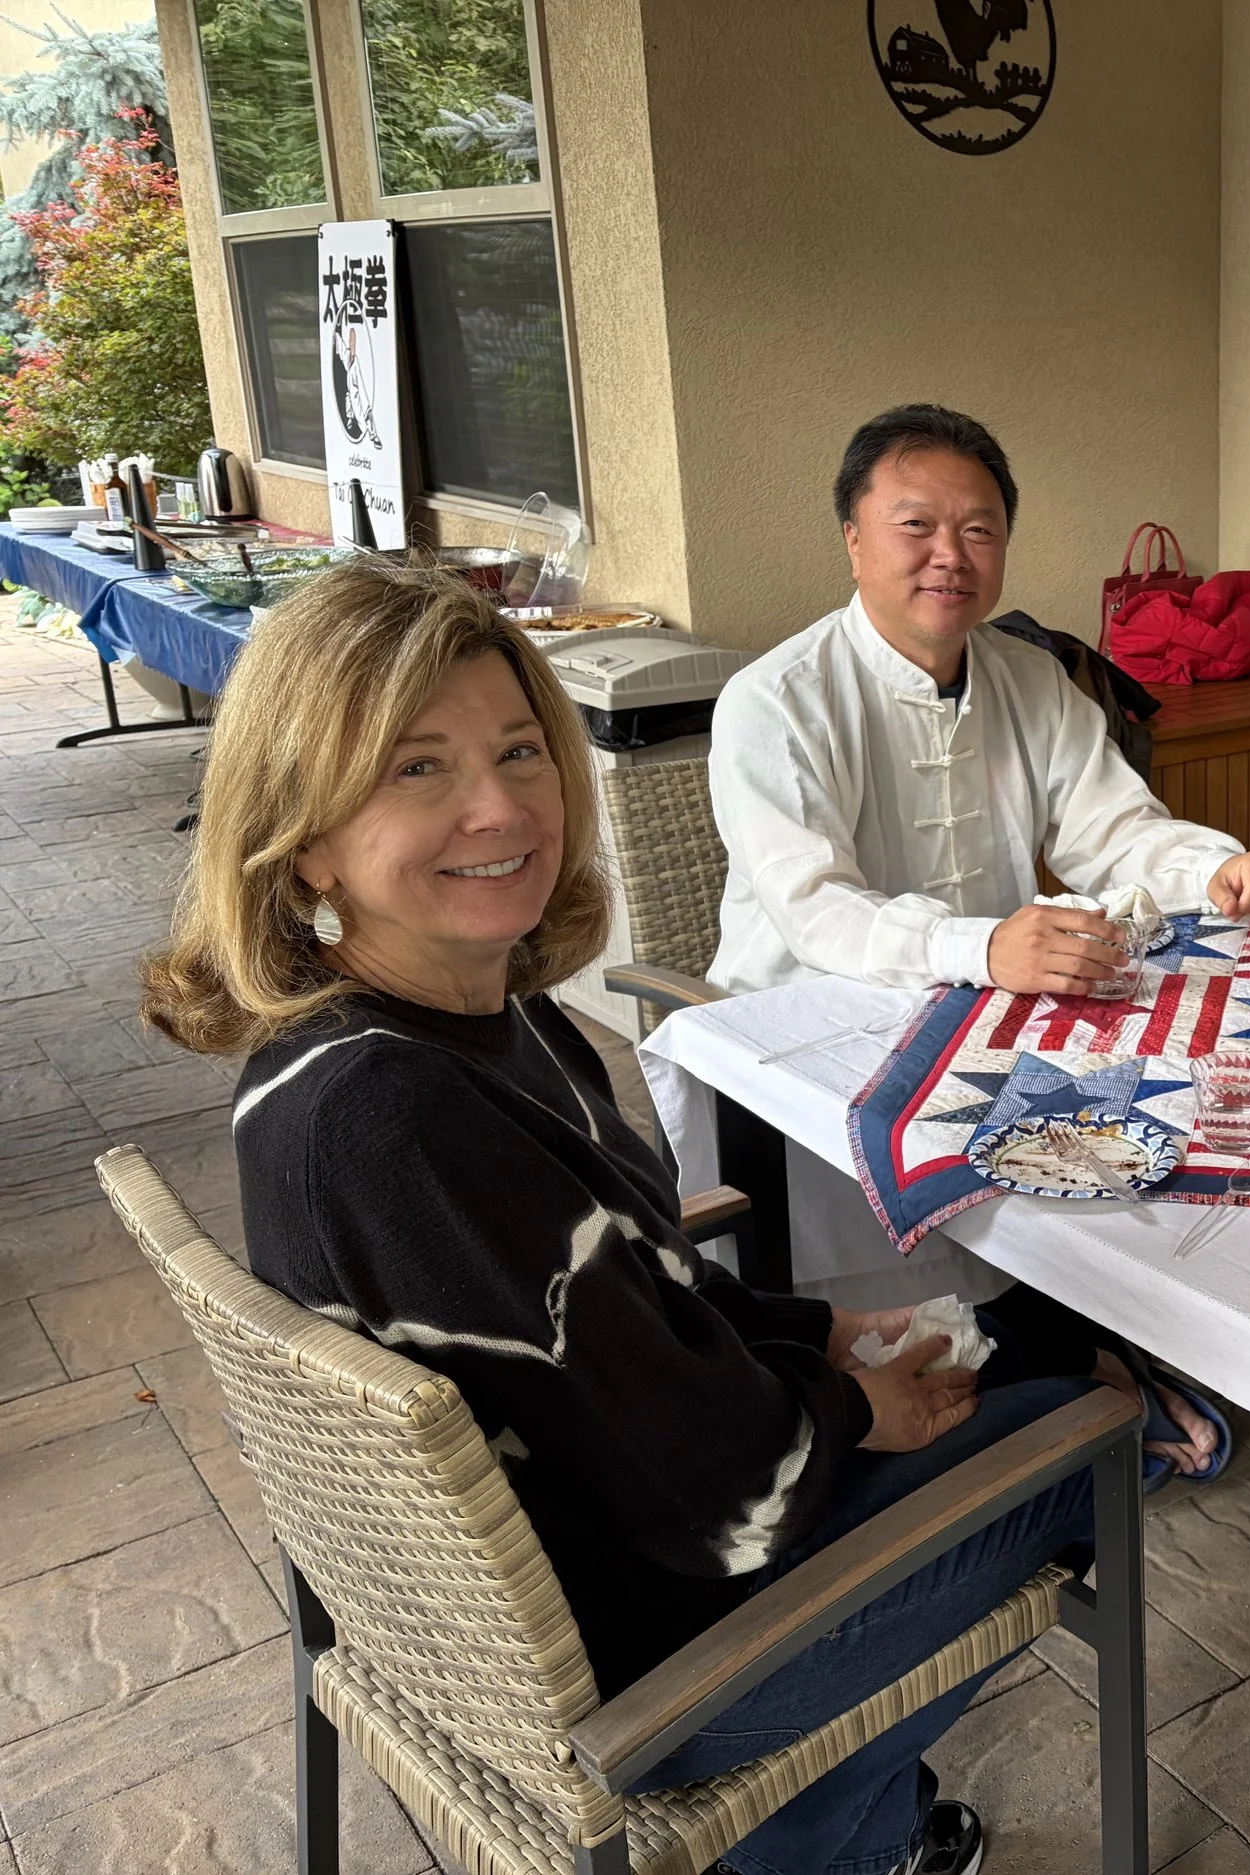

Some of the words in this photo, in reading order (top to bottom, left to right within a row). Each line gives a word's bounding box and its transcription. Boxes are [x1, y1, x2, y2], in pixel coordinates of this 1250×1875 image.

[323, 254, 387, 329] 太極拳
[333, 482, 344, 502] Tai
[364, 487, 395, 514] Chuan
